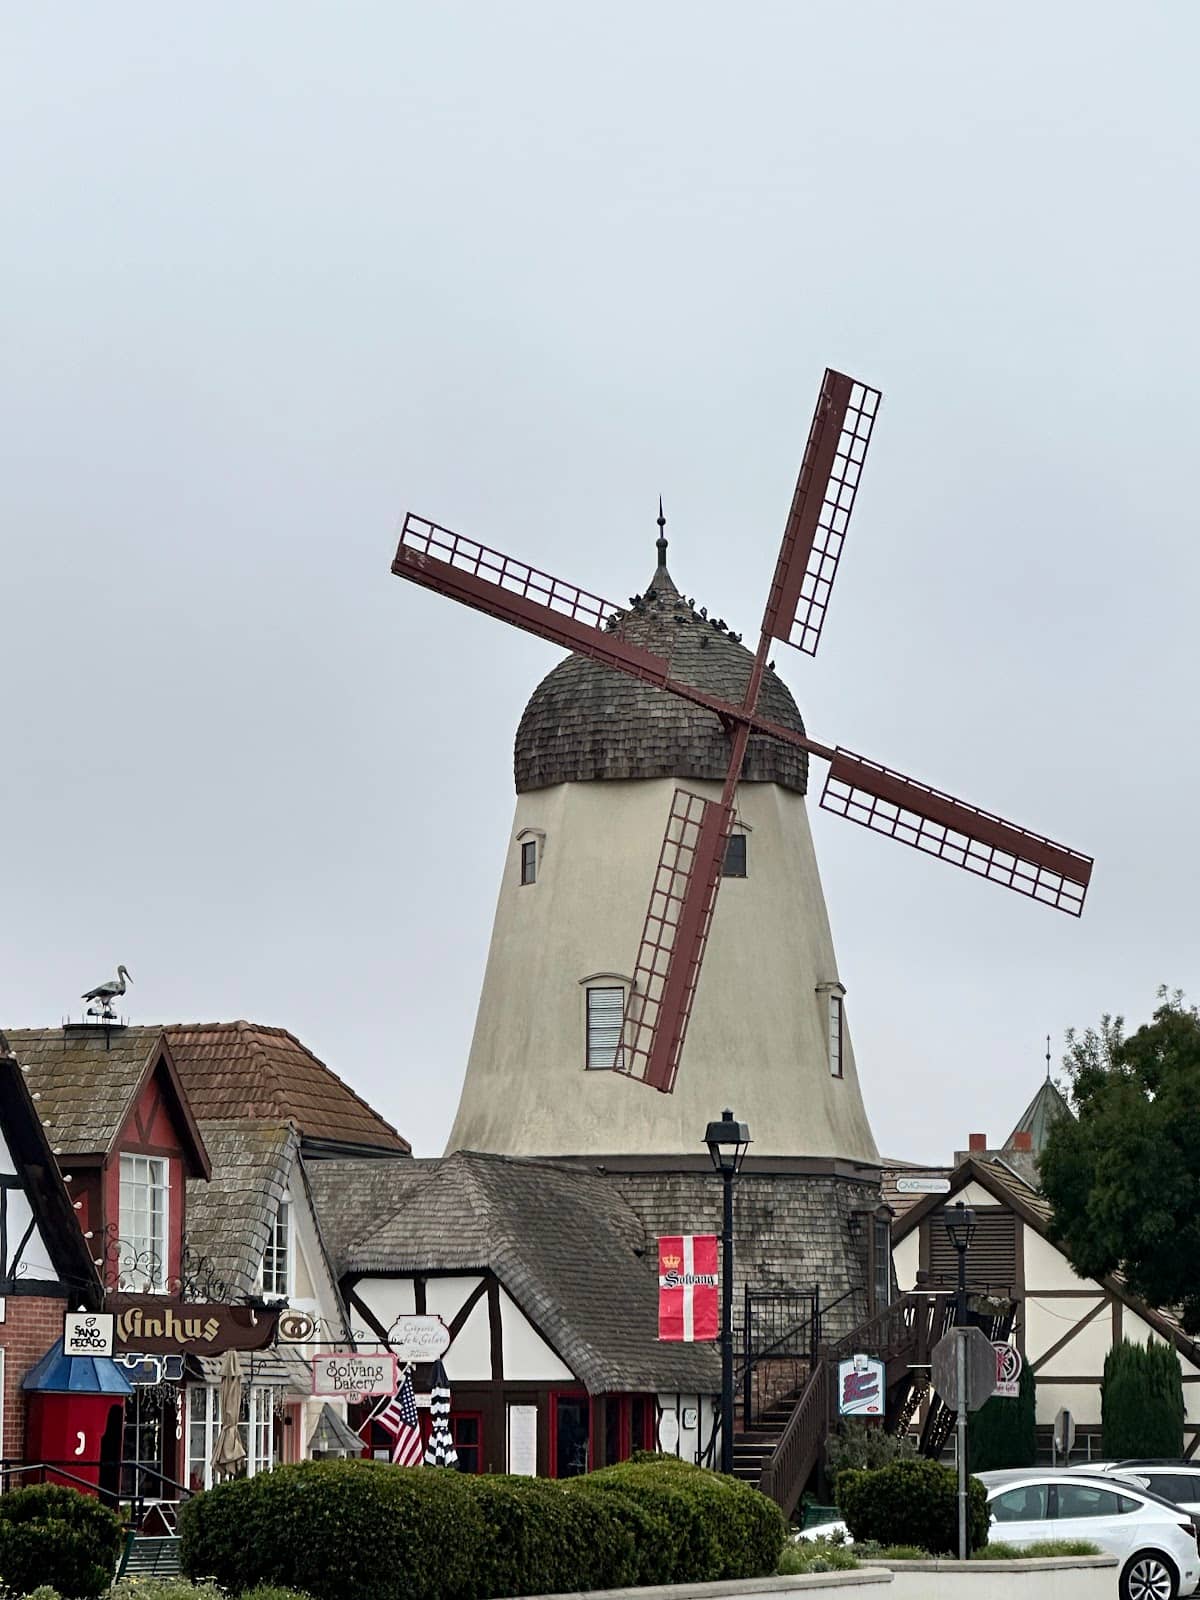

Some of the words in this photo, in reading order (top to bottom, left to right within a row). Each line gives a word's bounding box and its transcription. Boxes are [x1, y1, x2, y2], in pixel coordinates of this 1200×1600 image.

[664, 1270, 714, 1287] Solvang
[74, 1325, 100, 1338] SANO
[116, 1307, 220, 1343] Vinhus
[70, 1337, 107, 1348] PECADO
[326, 1360, 384, 1381] Solvang
[334, 1376, 376, 1393] Bakery
